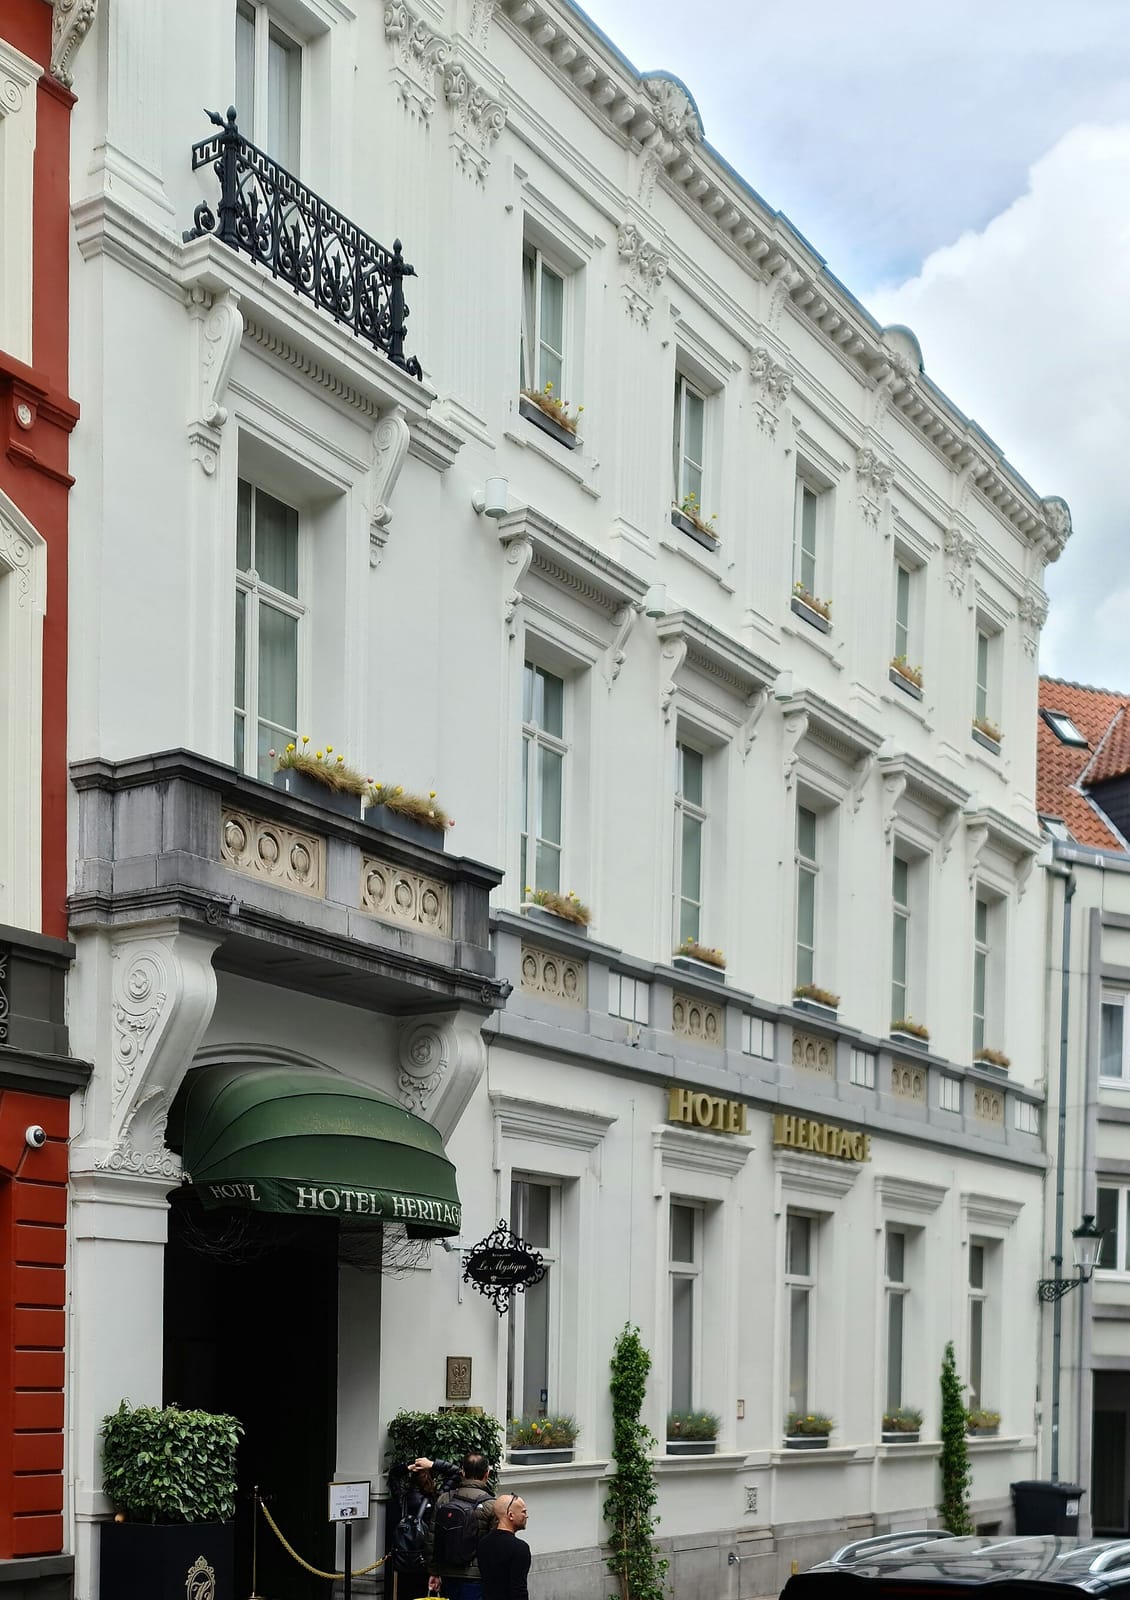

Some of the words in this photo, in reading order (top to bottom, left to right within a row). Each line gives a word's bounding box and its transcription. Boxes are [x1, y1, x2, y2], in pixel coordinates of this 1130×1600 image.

[669, 1088, 751, 1136] HOTEL
[774, 1114, 872, 1162] HERITAGE
[296, 1187, 383, 1216] HOTEL
[476, 1261, 488, 1271] Le
[490, 1259, 527, 1275] Mystique
